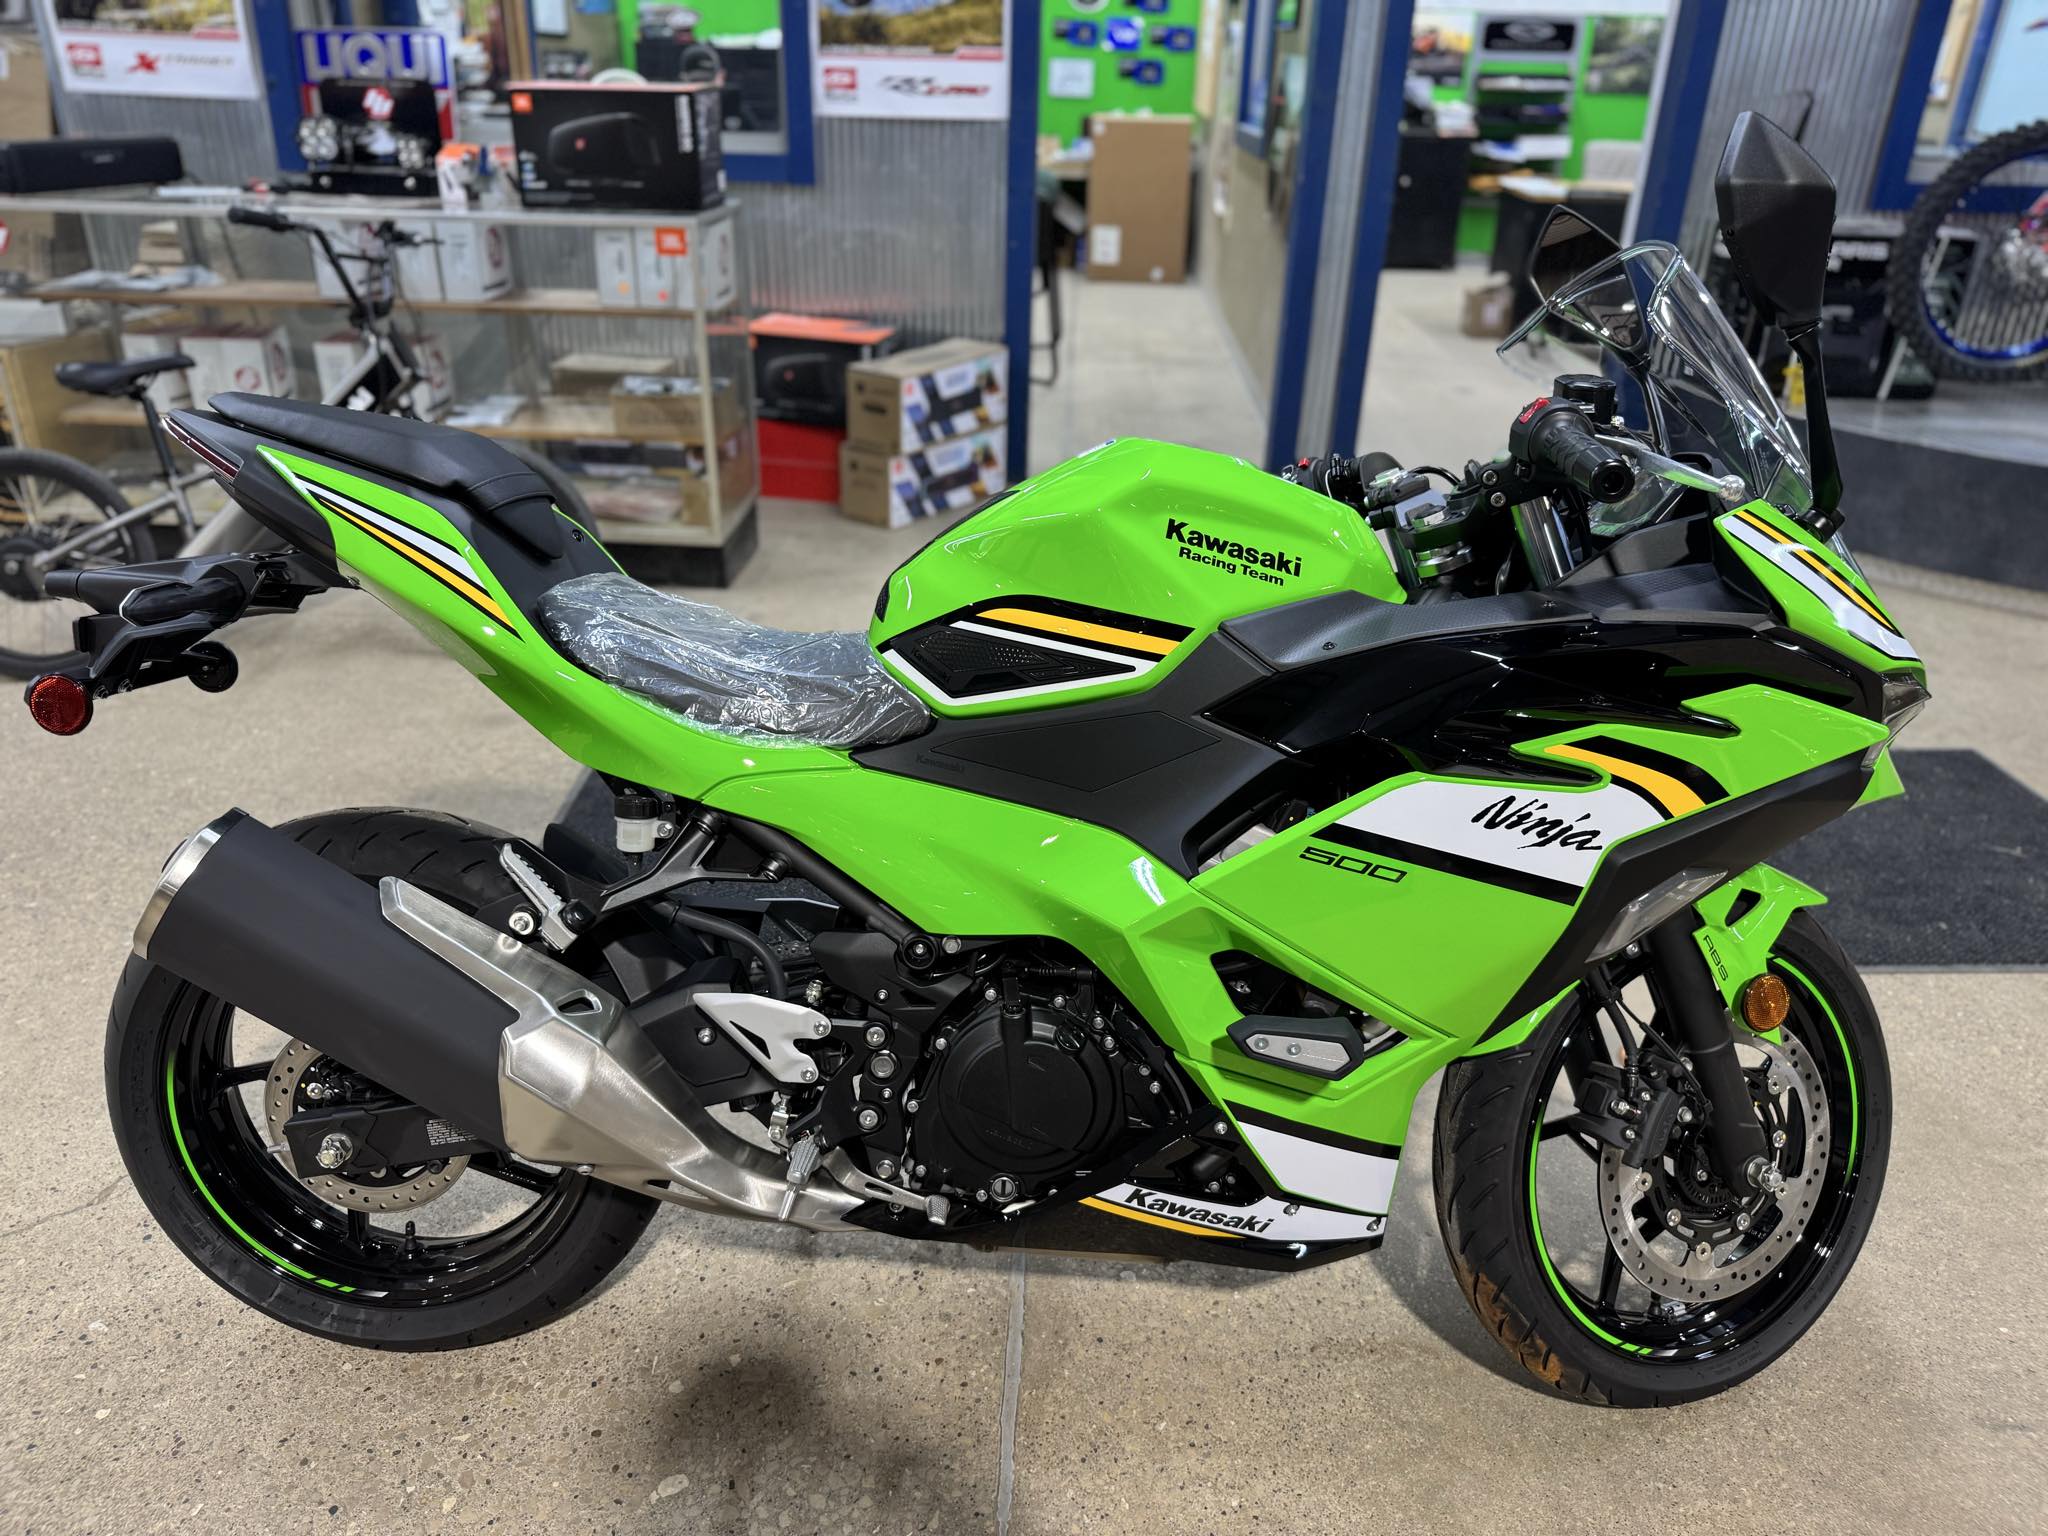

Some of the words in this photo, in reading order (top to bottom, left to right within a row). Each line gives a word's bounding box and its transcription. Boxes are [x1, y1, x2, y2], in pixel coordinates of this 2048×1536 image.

[301, 33, 449, 83] LIQUI
[1165, 518, 1302, 577] Kawasaki
[1178, 546, 1237, 574] Racing
[1240, 563, 1285, 586] Team
[1470, 795, 1603, 850] Ninja
[1299, 846, 1408, 883] 500
[1703, 935, 1729, 981] ABS
[1123, 1188, 1275, 1234] Kawasaki
